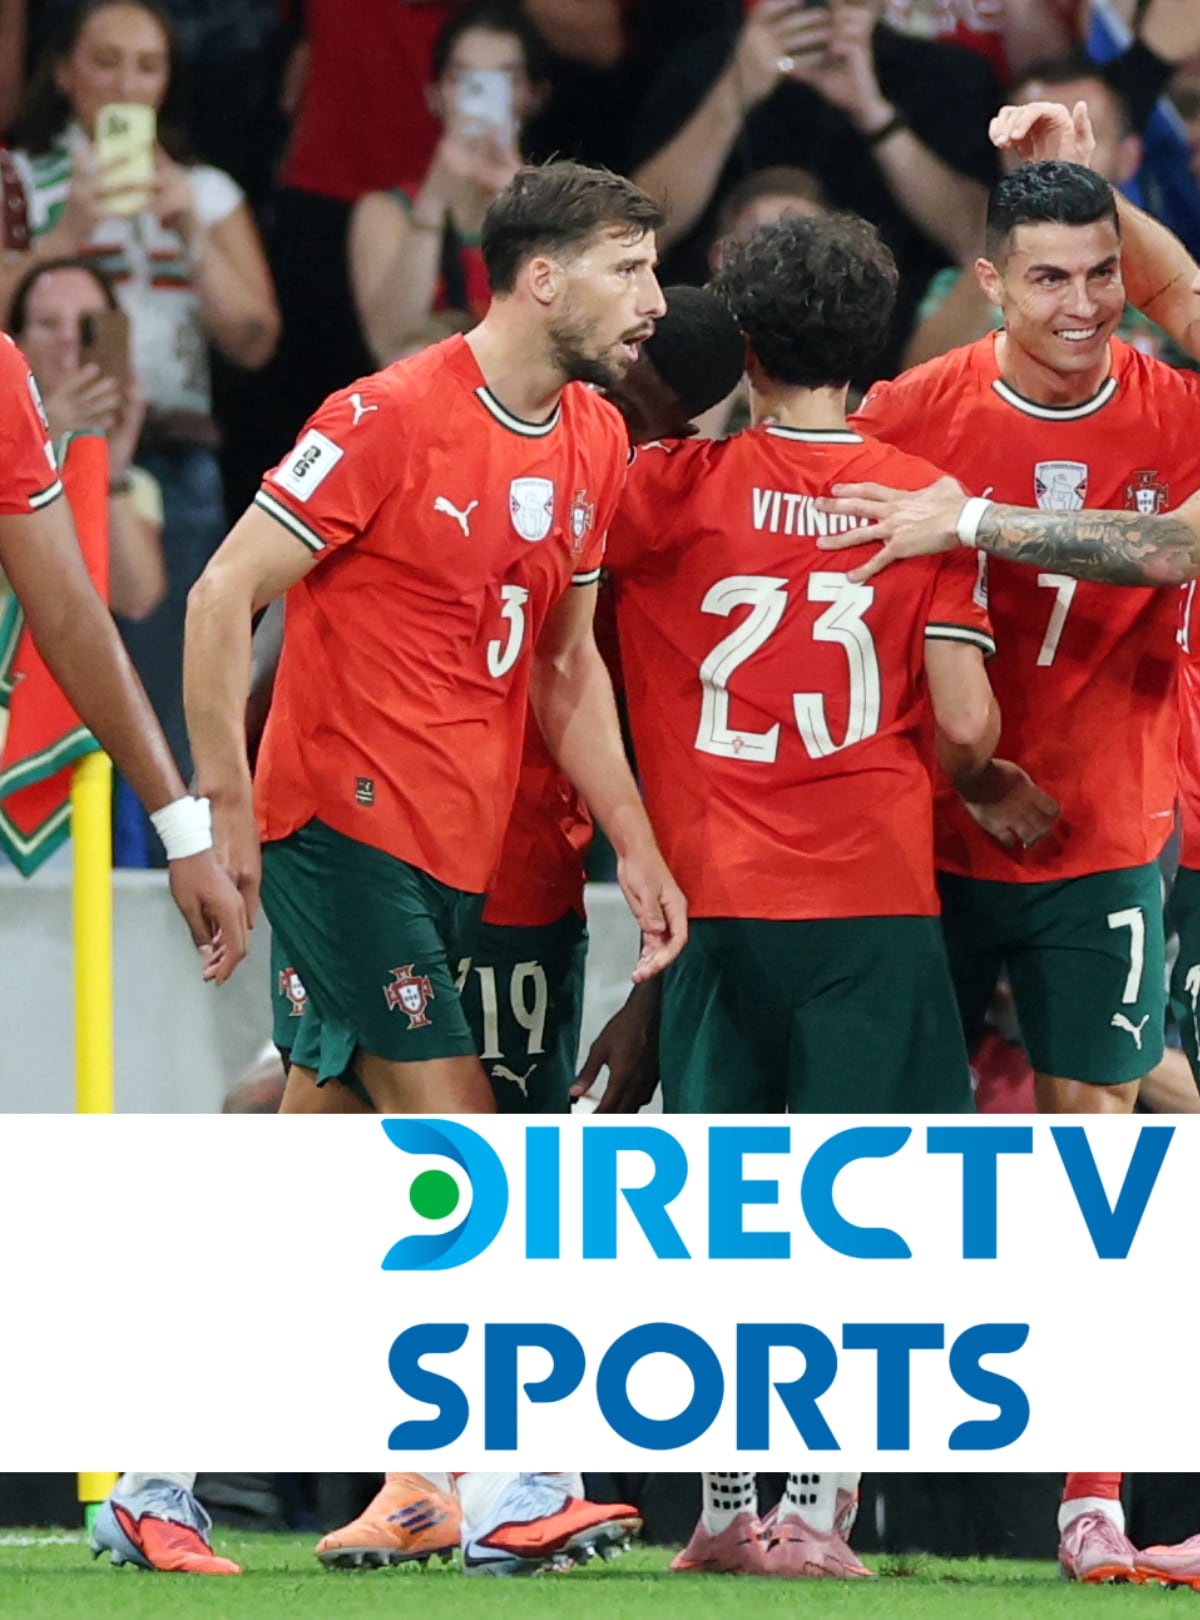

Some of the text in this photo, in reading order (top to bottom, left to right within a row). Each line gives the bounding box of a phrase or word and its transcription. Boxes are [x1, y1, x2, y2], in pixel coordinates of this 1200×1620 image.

[486, 584, 530, 678] 3
[694, 571, 881, 764] 23
[1036, 573, 1078, 667] 7
[1107, 906, 1145, 1004] 7
[473, 960, 548, 1059] 19
